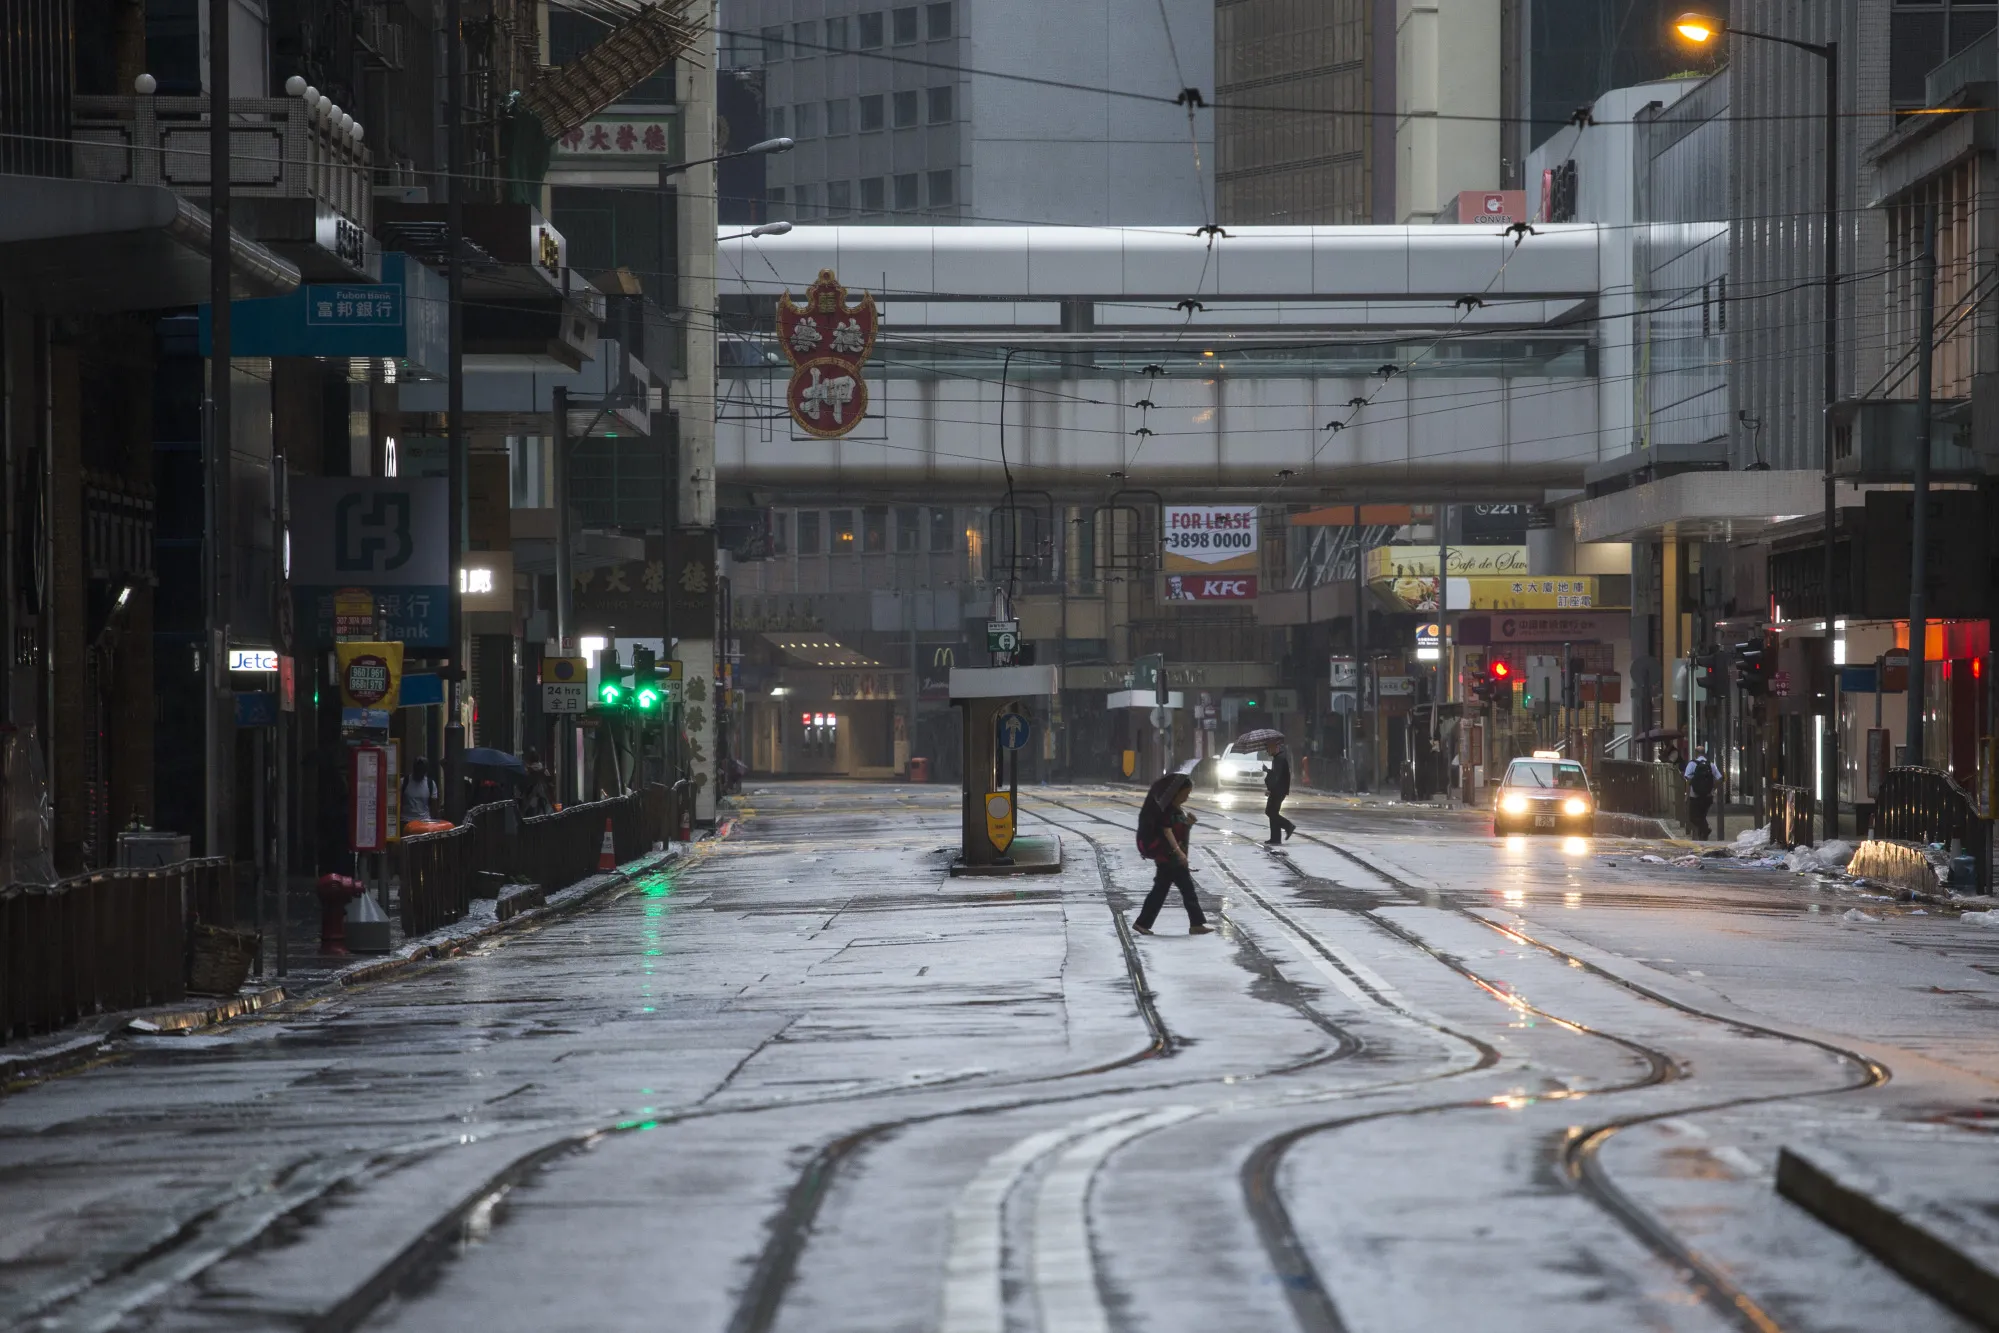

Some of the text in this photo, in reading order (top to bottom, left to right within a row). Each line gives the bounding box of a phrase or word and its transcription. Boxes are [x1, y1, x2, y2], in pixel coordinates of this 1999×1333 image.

[1474, 216, 1512, 224] CONVEY
[337, 292, 391, 300] Fubon Bank
[317, 302, 392, 318] 富邦銀行
[799, 367, 856, 425] 押
[1172, 513, 1250, 529] FOR LEASE
[1171, 532, 1251, 548] 3898 0000
[1478, 558, 1492, 569] de
[1204, 580, 1248, 596] KFC
[1512, 582, 1585, 593] 本大廈地庫
[317, 594, 431, 618] 富銀行
[353, 667, 366, 677] 960
[370, 680, 383, 689] 978
[547, 686, 581, 695] 24 hrs
[831, 673, 859, 695] HSBC
